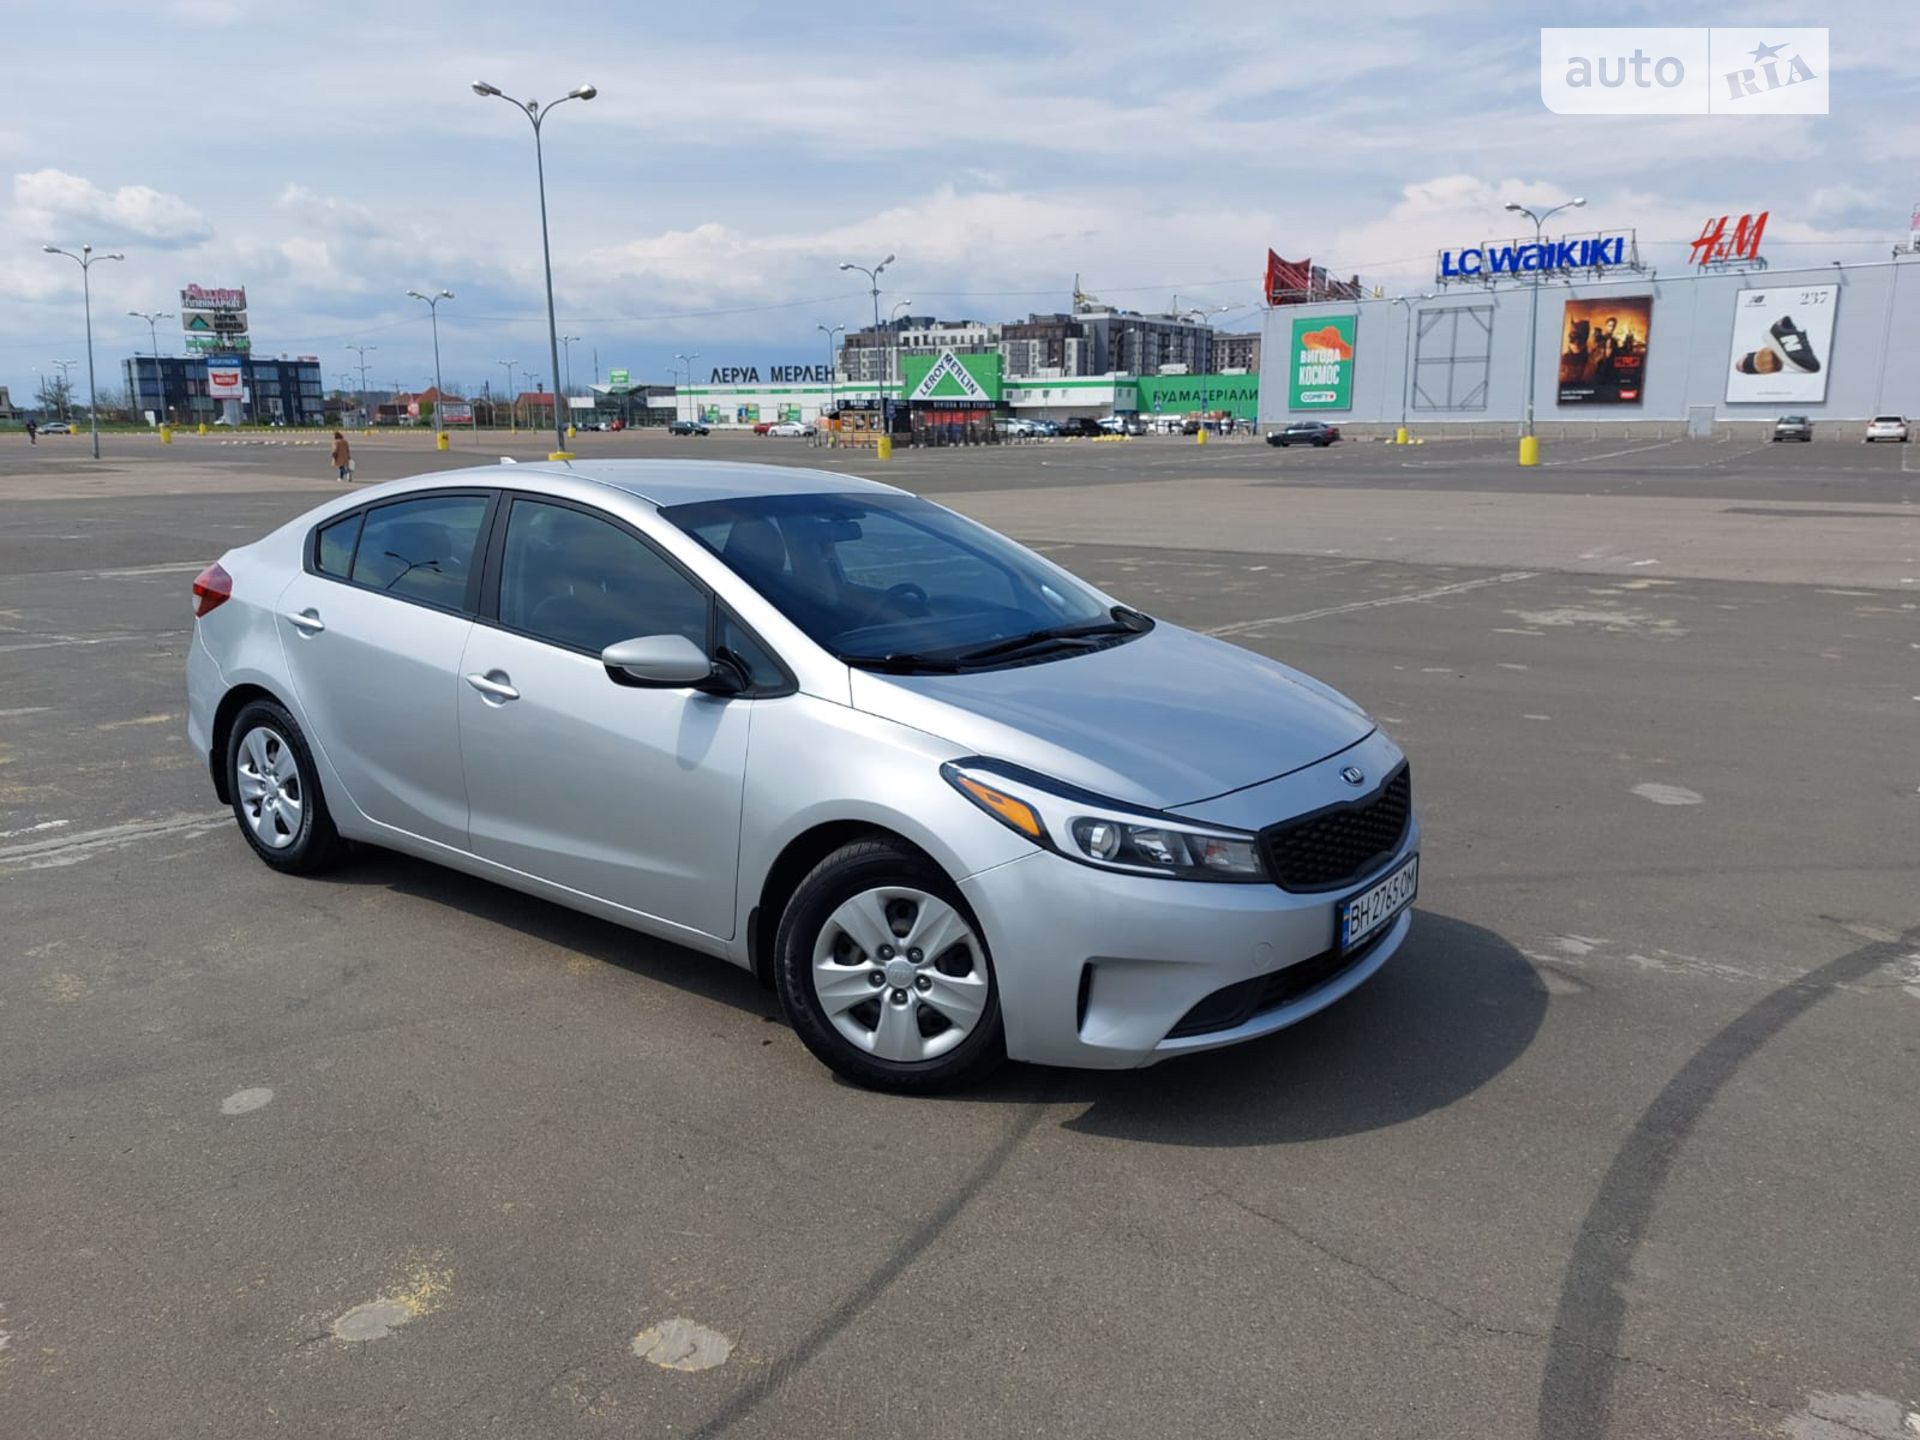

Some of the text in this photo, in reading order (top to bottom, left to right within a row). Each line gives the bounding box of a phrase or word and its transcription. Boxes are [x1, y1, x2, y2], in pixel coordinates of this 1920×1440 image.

[1689, 211, 1769, 265] H&M
[1442, 249, 1482, 277] LC
[1799, 291, 1830, 305] 237
[1300, 348, 1341, 364] ВИГОДА
[710, 365, 835, 384] ЛЕРУА МЕРЛЕН
[919, 352, 979, 397] LEROY MERLIN
[1299, 364, 1340, 385] КОСМОС
[1350, 862, 1416, 936] BH 2765 OM
